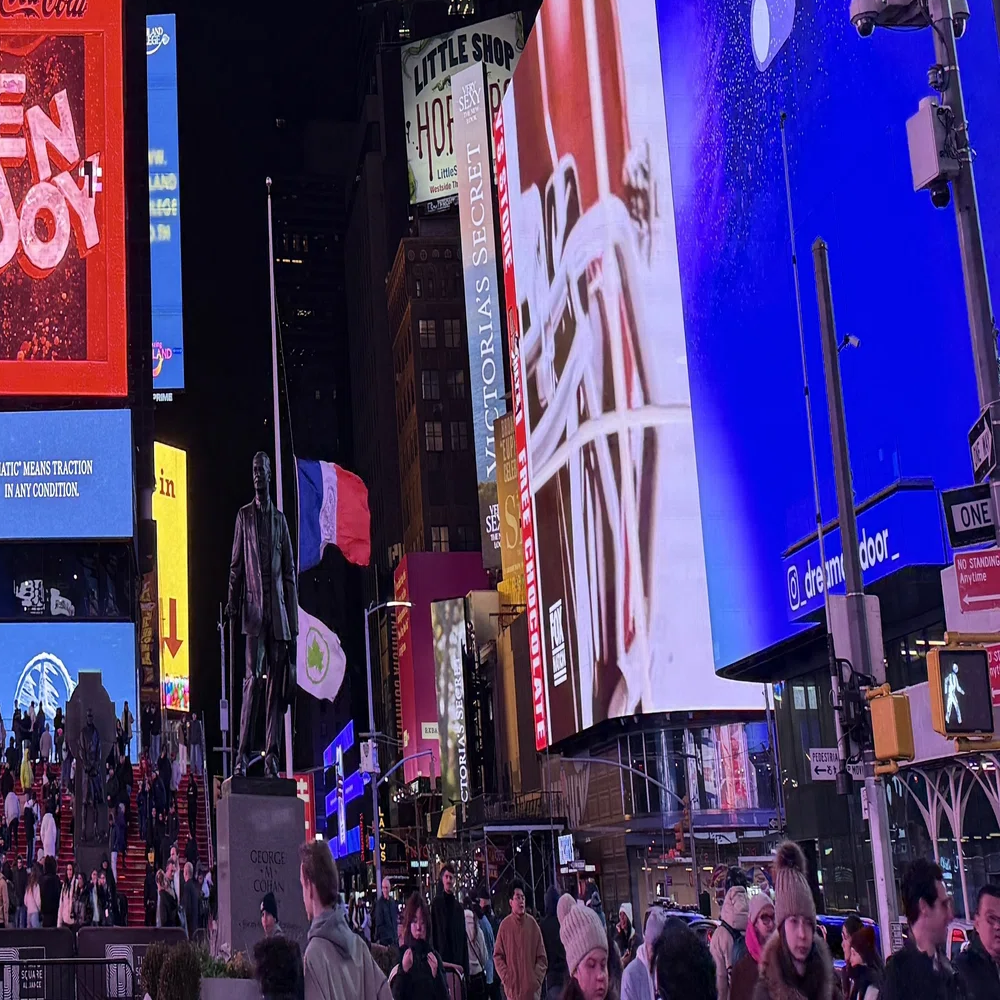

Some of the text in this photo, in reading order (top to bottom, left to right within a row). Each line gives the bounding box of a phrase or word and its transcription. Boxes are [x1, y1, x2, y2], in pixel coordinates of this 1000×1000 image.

[413, 33, 515, 96] LITTLE SHOP
[459, 87, 481, 113] SEXY
[471, 143, 503, 480] VICTORIA'S SECRET
[23, 461, 51, 476] MEANS
[52, 459, 93, 475] TRACTION
[4, 481, 80, 498] IN ANY CONDITION.
[517, 446, 532, 526] FREE
[960, 503, 992, 528] ONE
[957, 557, 968, 570] NO
[959, 570, 988, 586] Anytime
[523, 534, 547, 743] CHOCOLATE
[250, 850, 287, 865] GEORGE
[253, 878, 285, 893] COHAN
